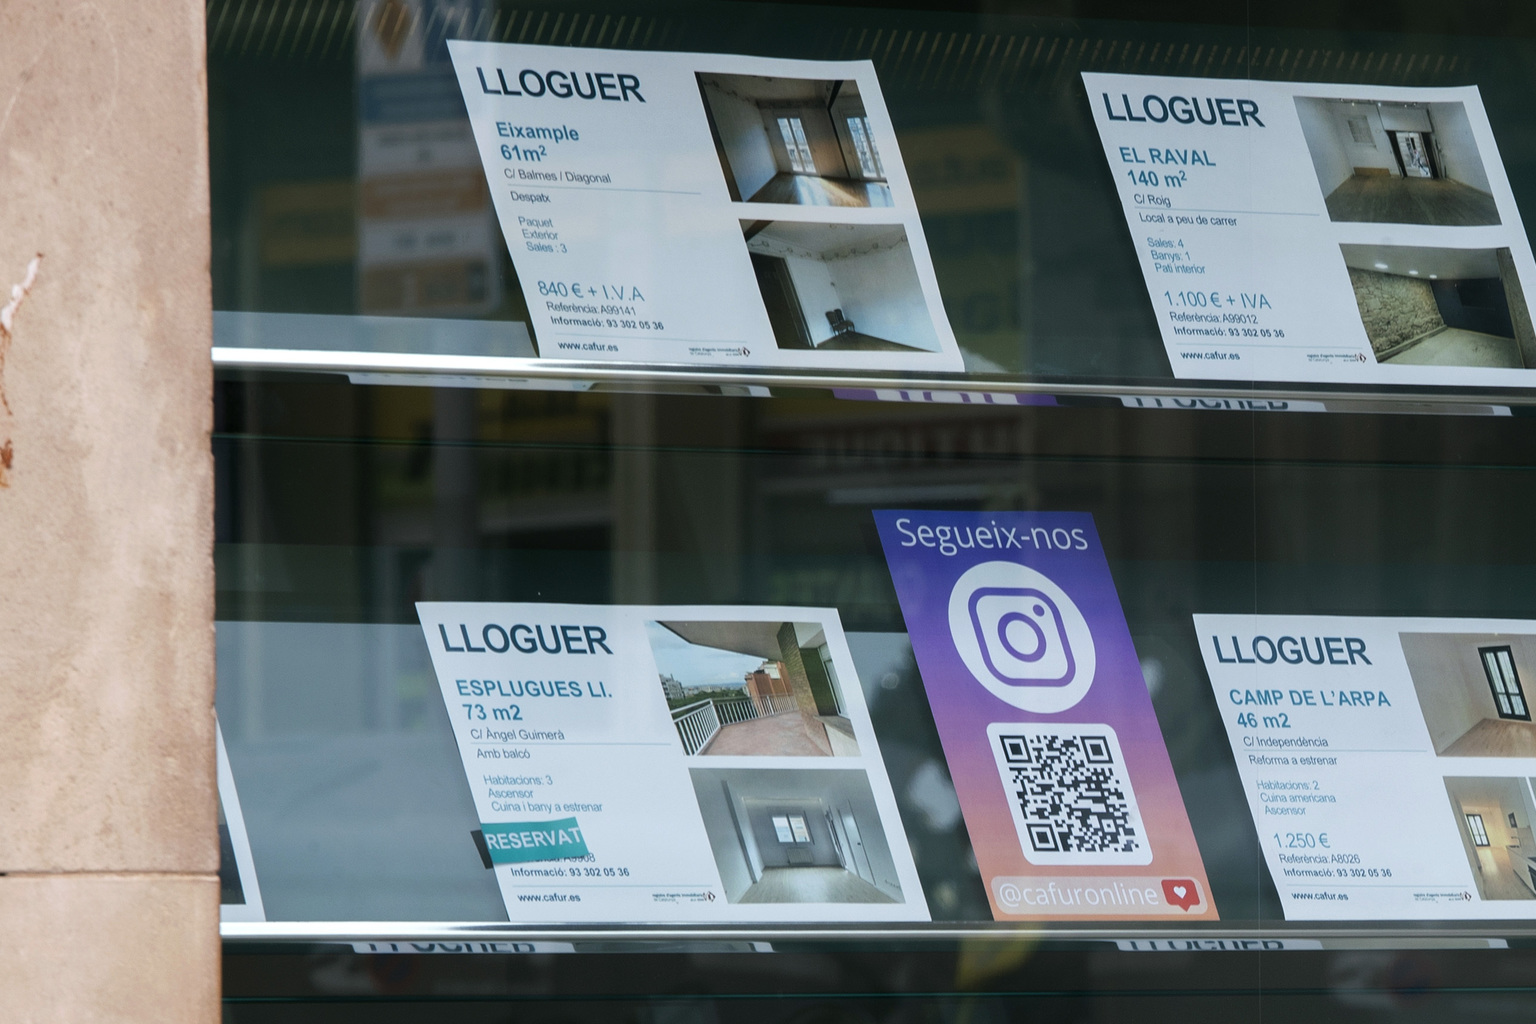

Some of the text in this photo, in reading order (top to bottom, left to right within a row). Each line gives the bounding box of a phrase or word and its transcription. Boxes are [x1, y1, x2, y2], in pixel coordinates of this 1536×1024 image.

[476, 66, 647, 102] LLOGUER
[1102, 92, 1266, 128] LLOGUER
[496, 121, 580, 143] Eixample
[1119, 146, 1216, 167] EL RAVAL
[504, 168, 611, 185] C/ Balmes Diagonal
[1127, 169, 1159, 187] 140
[510, 191, 550, 204] Despatx
[1133, 194, 1171, 208] C/ Roig
[1139, 212, 1237, 227] Local a peu de carrer
[538, 280, 568, 297] 840
[572, 283, 583, 298] €
[588, 288, 597, 297] +
[1164, 290, 1272, 310] 1.100 € + IVA
[558, 341, 618, 352] www.cafur.es
[1180, 350, 1240, 361] www.cafur.es
[896, 518, 1088, 556] Segueix-nos
[438, 623, 613, 655] LLOGUER
[1212, 635, 1372, 665] LLOGUER
[455, 679, 582, 698] ESPLUGUES
[1229, 689, 1283, 705] CAMP
[1288, 690, 1316, 706] DE
[462, 704, 522, 721] 73 m2
[1237, 713, 1291, 728] 46 m2
[470, 727, 565, 742] C/ Àngel Guimerà
[1243, 736, 1328, 749] C/ Independència
[477, 749, 530, 759] Amb balcó
[1249, 755, 1289, 765] Reforma
[1300, 756, 1337, 766] estrenar
[484, 775, 552, 785] Habitacions: 3
[485, 827, 580, 850] RESERVAT
[1274, 832, 1331, 848] 1.250 €
[1284, 869, 1392, 878] Informació: 93 302 05 36
[518, 892, 580, 902] www.cafur.es
[999, 882, 1159, 907] @cafuronline
[1291, 892, 1348, 901] www.cafur.es
